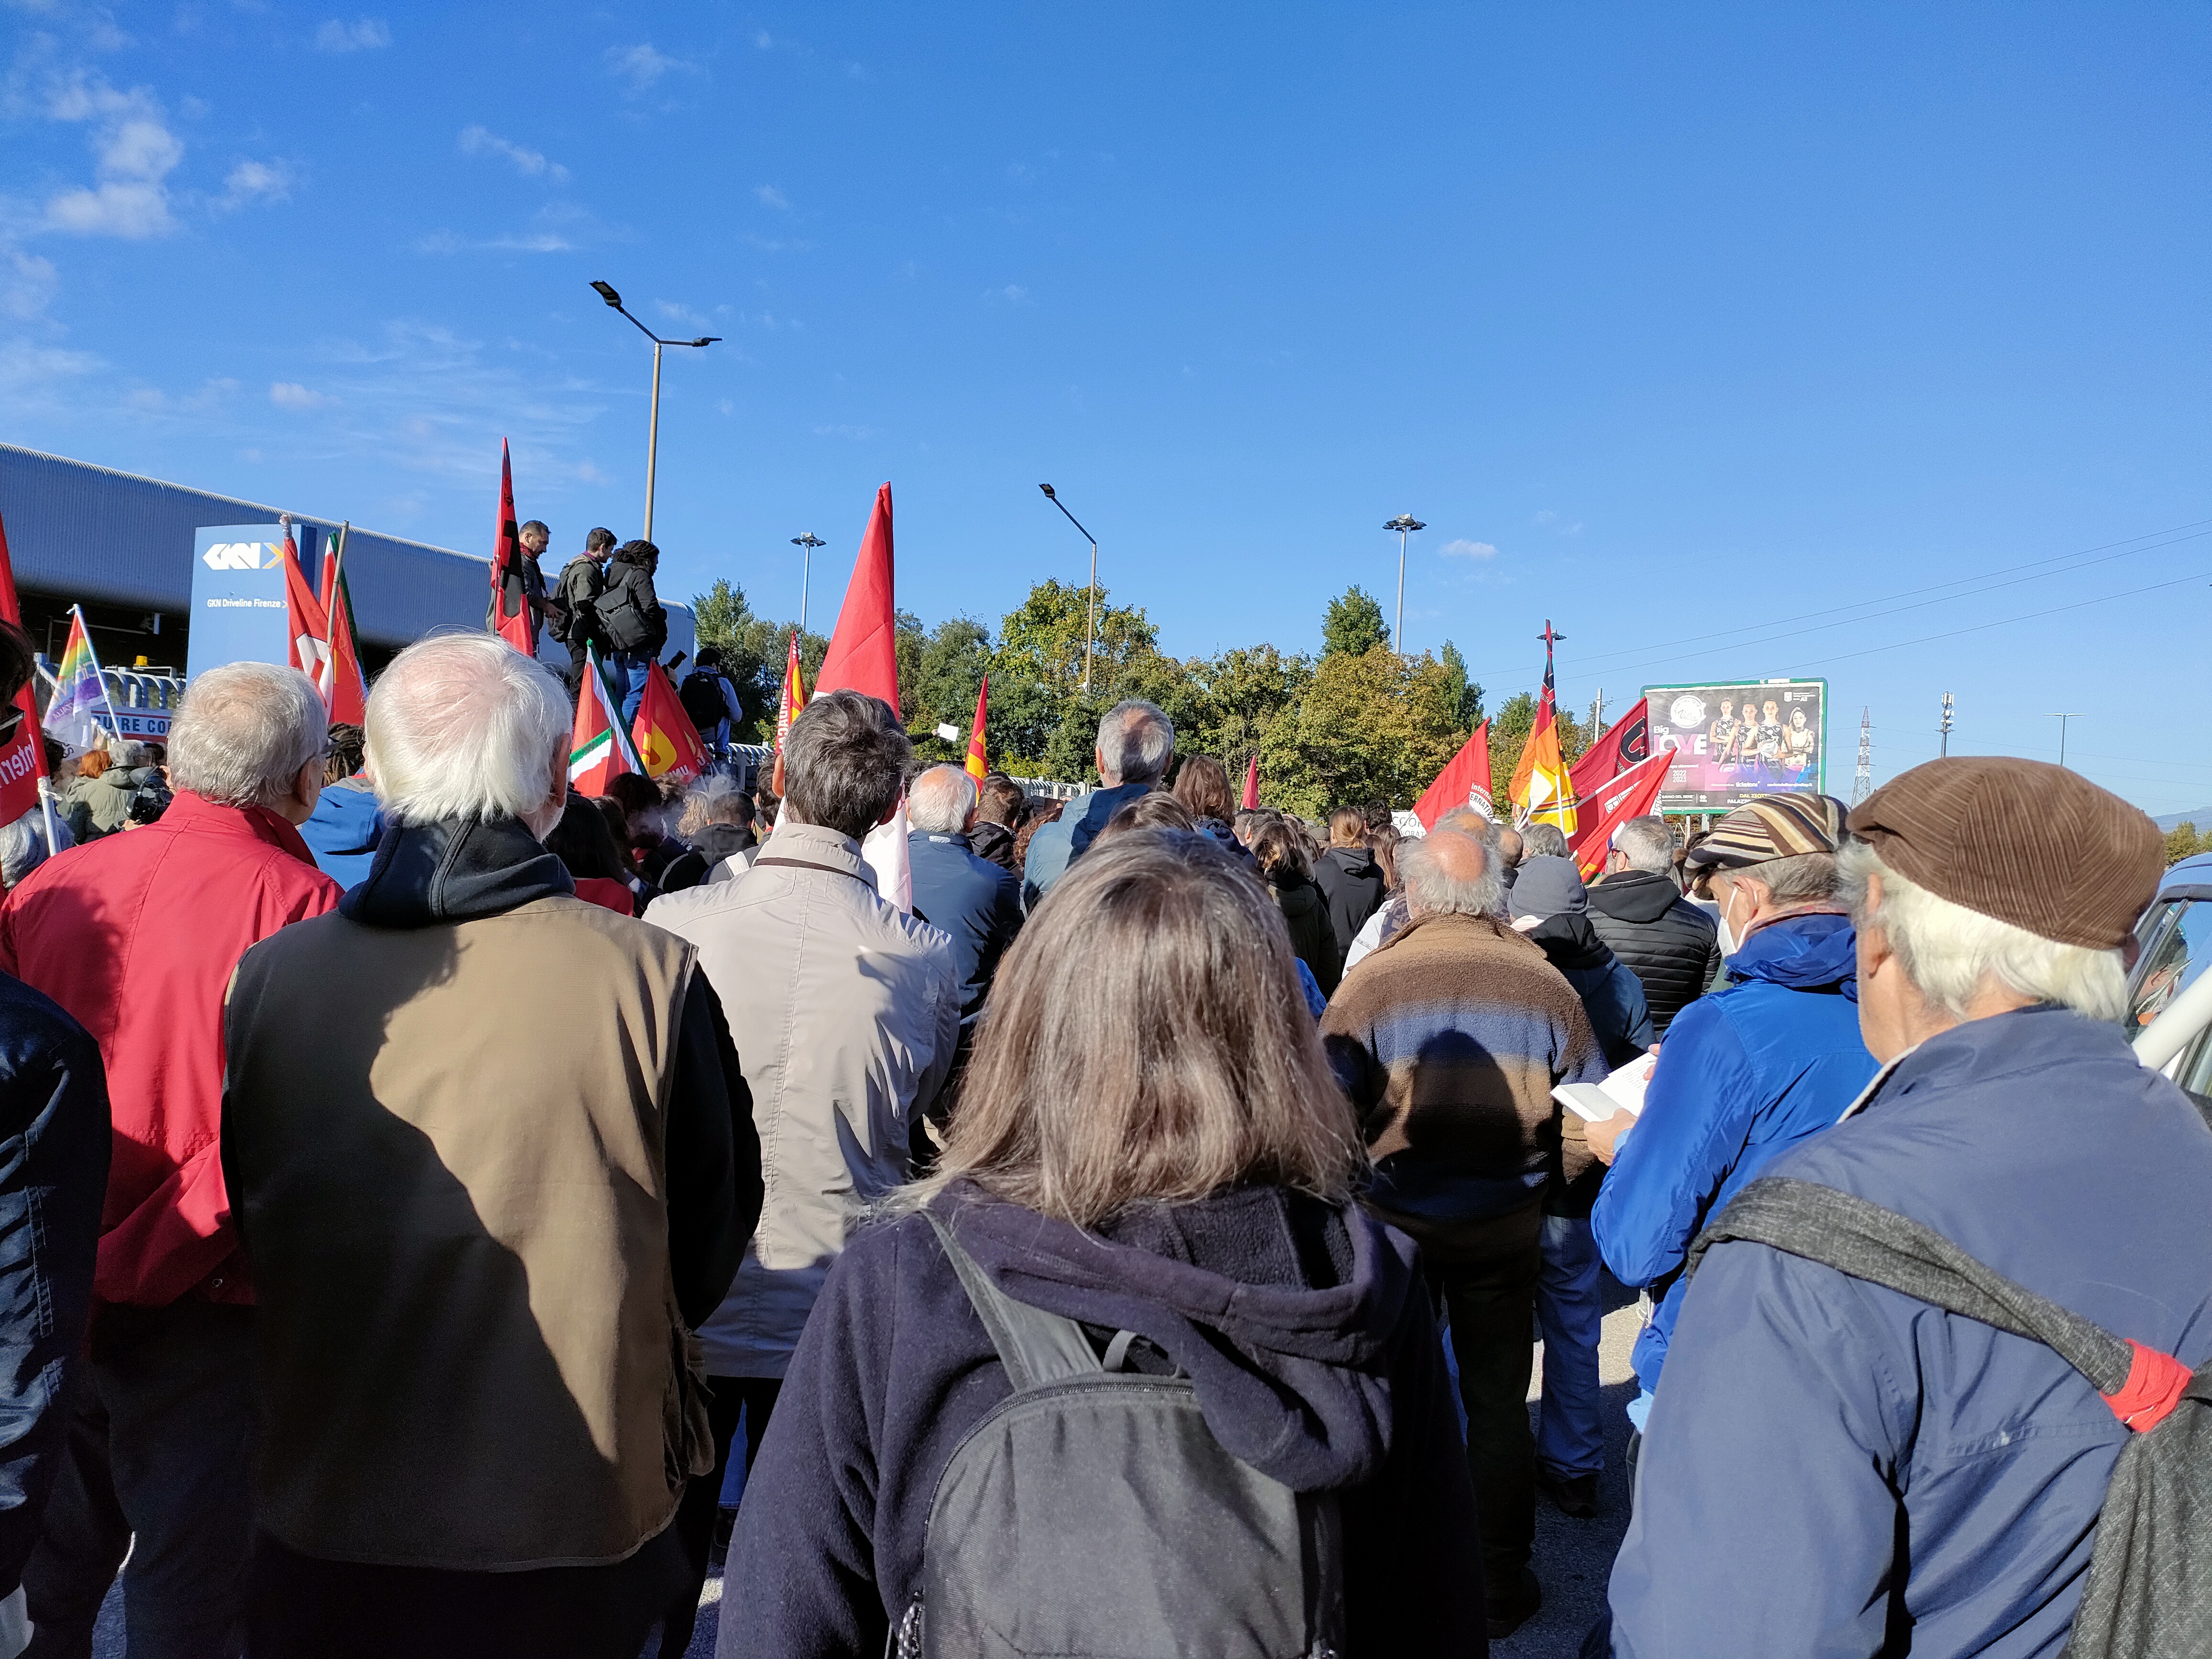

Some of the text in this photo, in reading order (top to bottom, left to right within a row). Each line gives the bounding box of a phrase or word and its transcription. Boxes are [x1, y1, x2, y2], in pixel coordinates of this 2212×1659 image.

[202, 542, 261, 570] GKN
[207, 598, 281, 608] GKN Driveline Firenze
[93, 715, 171, 734] URE CO
[1653, 725, 1670, 735] Big
[1653, 734, 1707, 755] LOVE
